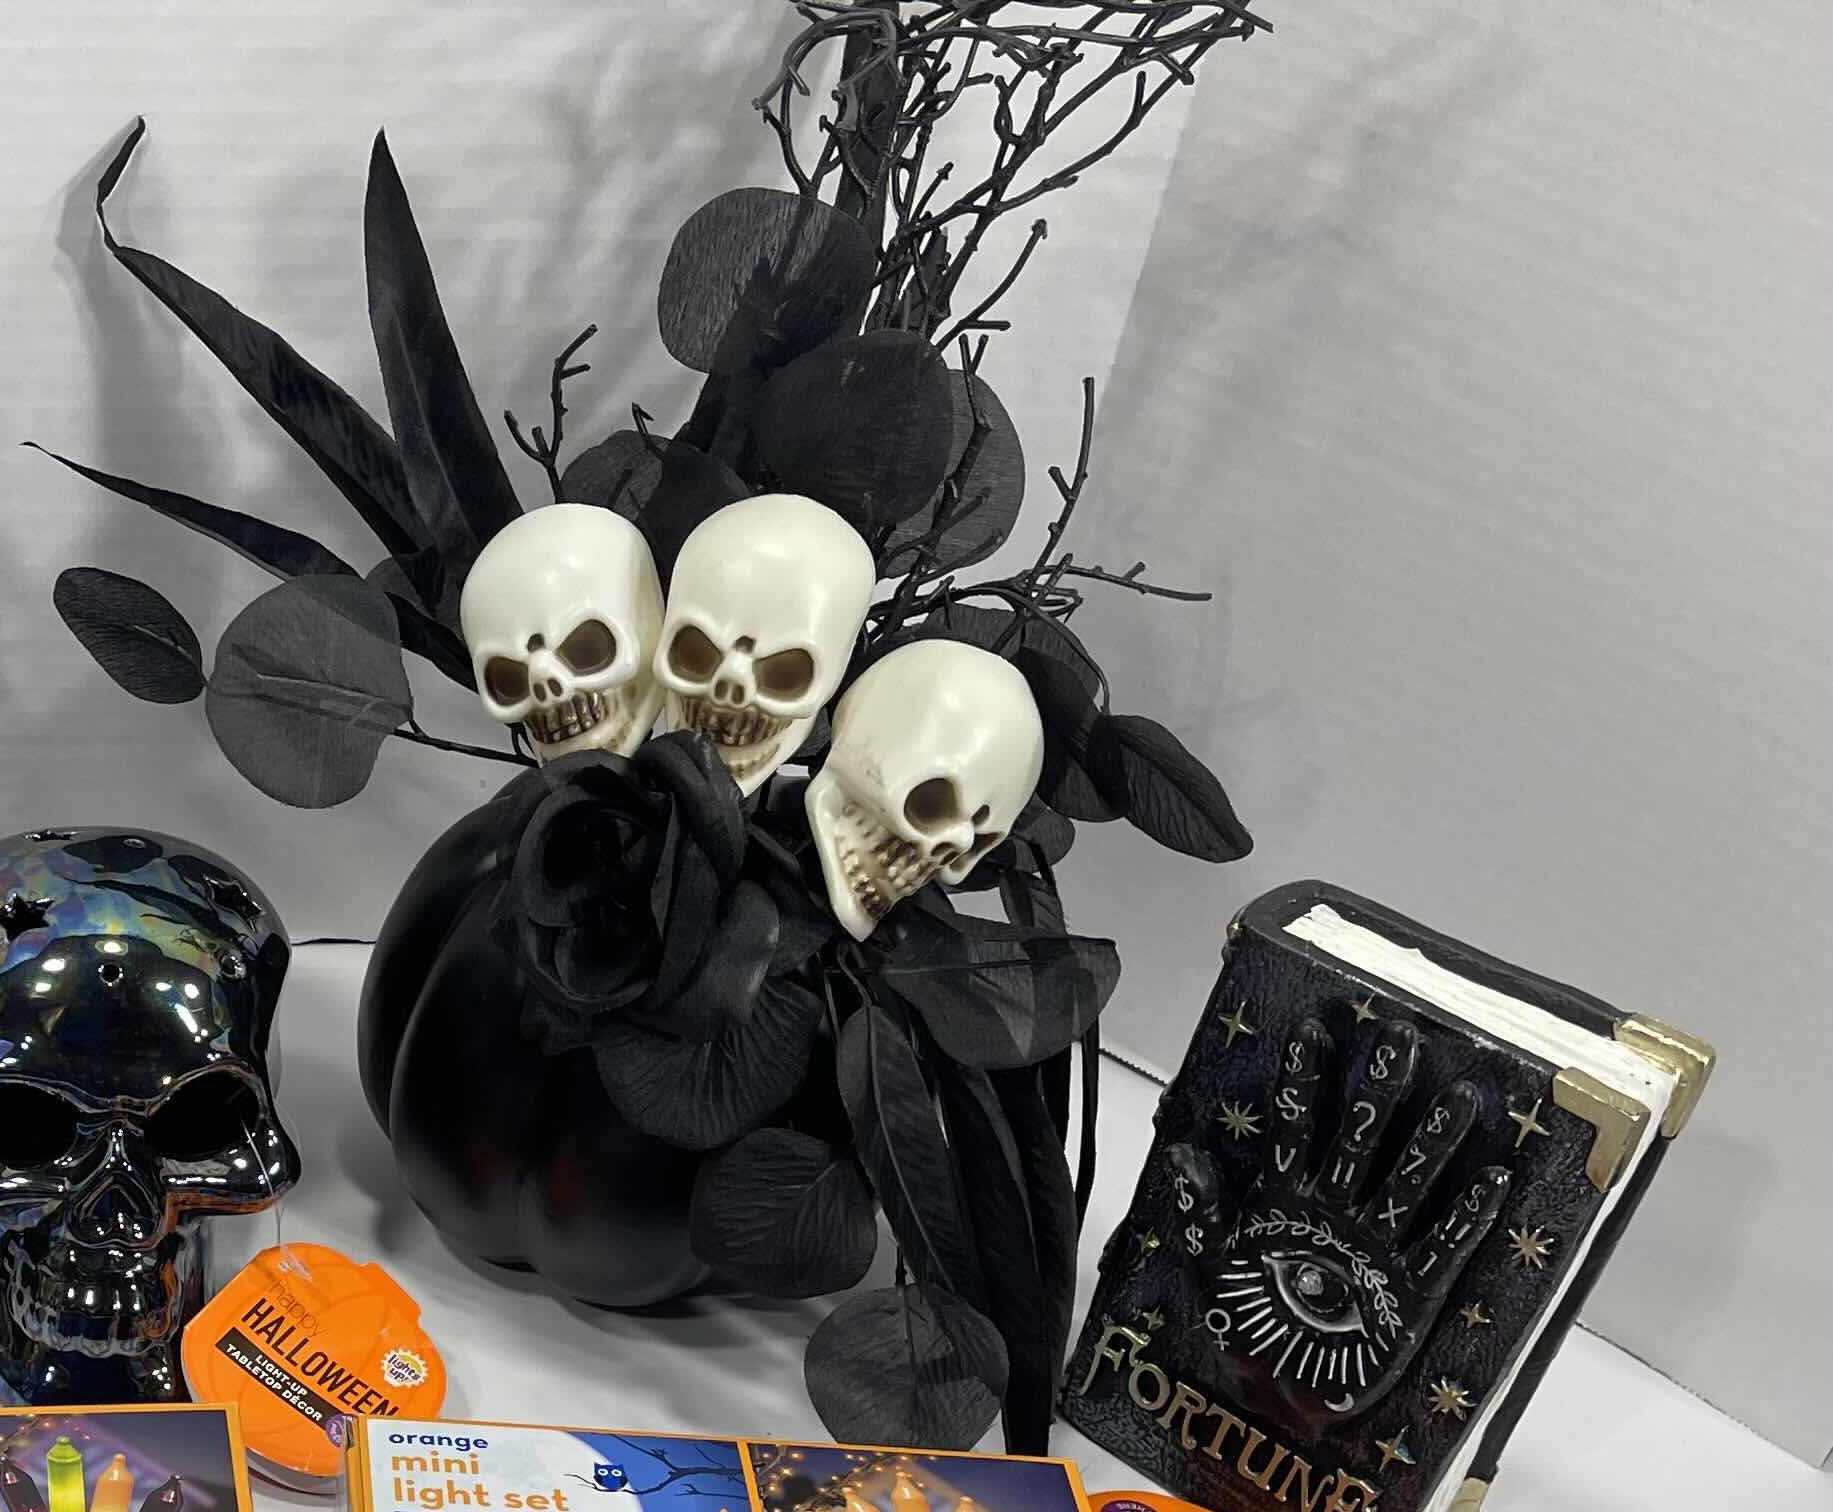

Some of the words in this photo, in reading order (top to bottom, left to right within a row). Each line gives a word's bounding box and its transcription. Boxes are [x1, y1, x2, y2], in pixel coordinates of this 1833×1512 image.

[268, 1279, 328, 1337] happy
[225, 1341, 285, 1393] TABLETOP
[255, 1353, 309, 1397] LIGHT-UP
[388, 1433, 489, 1452] orange
[391, 1450, 480, 1475] mini
[392, 1477, 491, 1510] light
[503, 1488, 570, 1512] set
